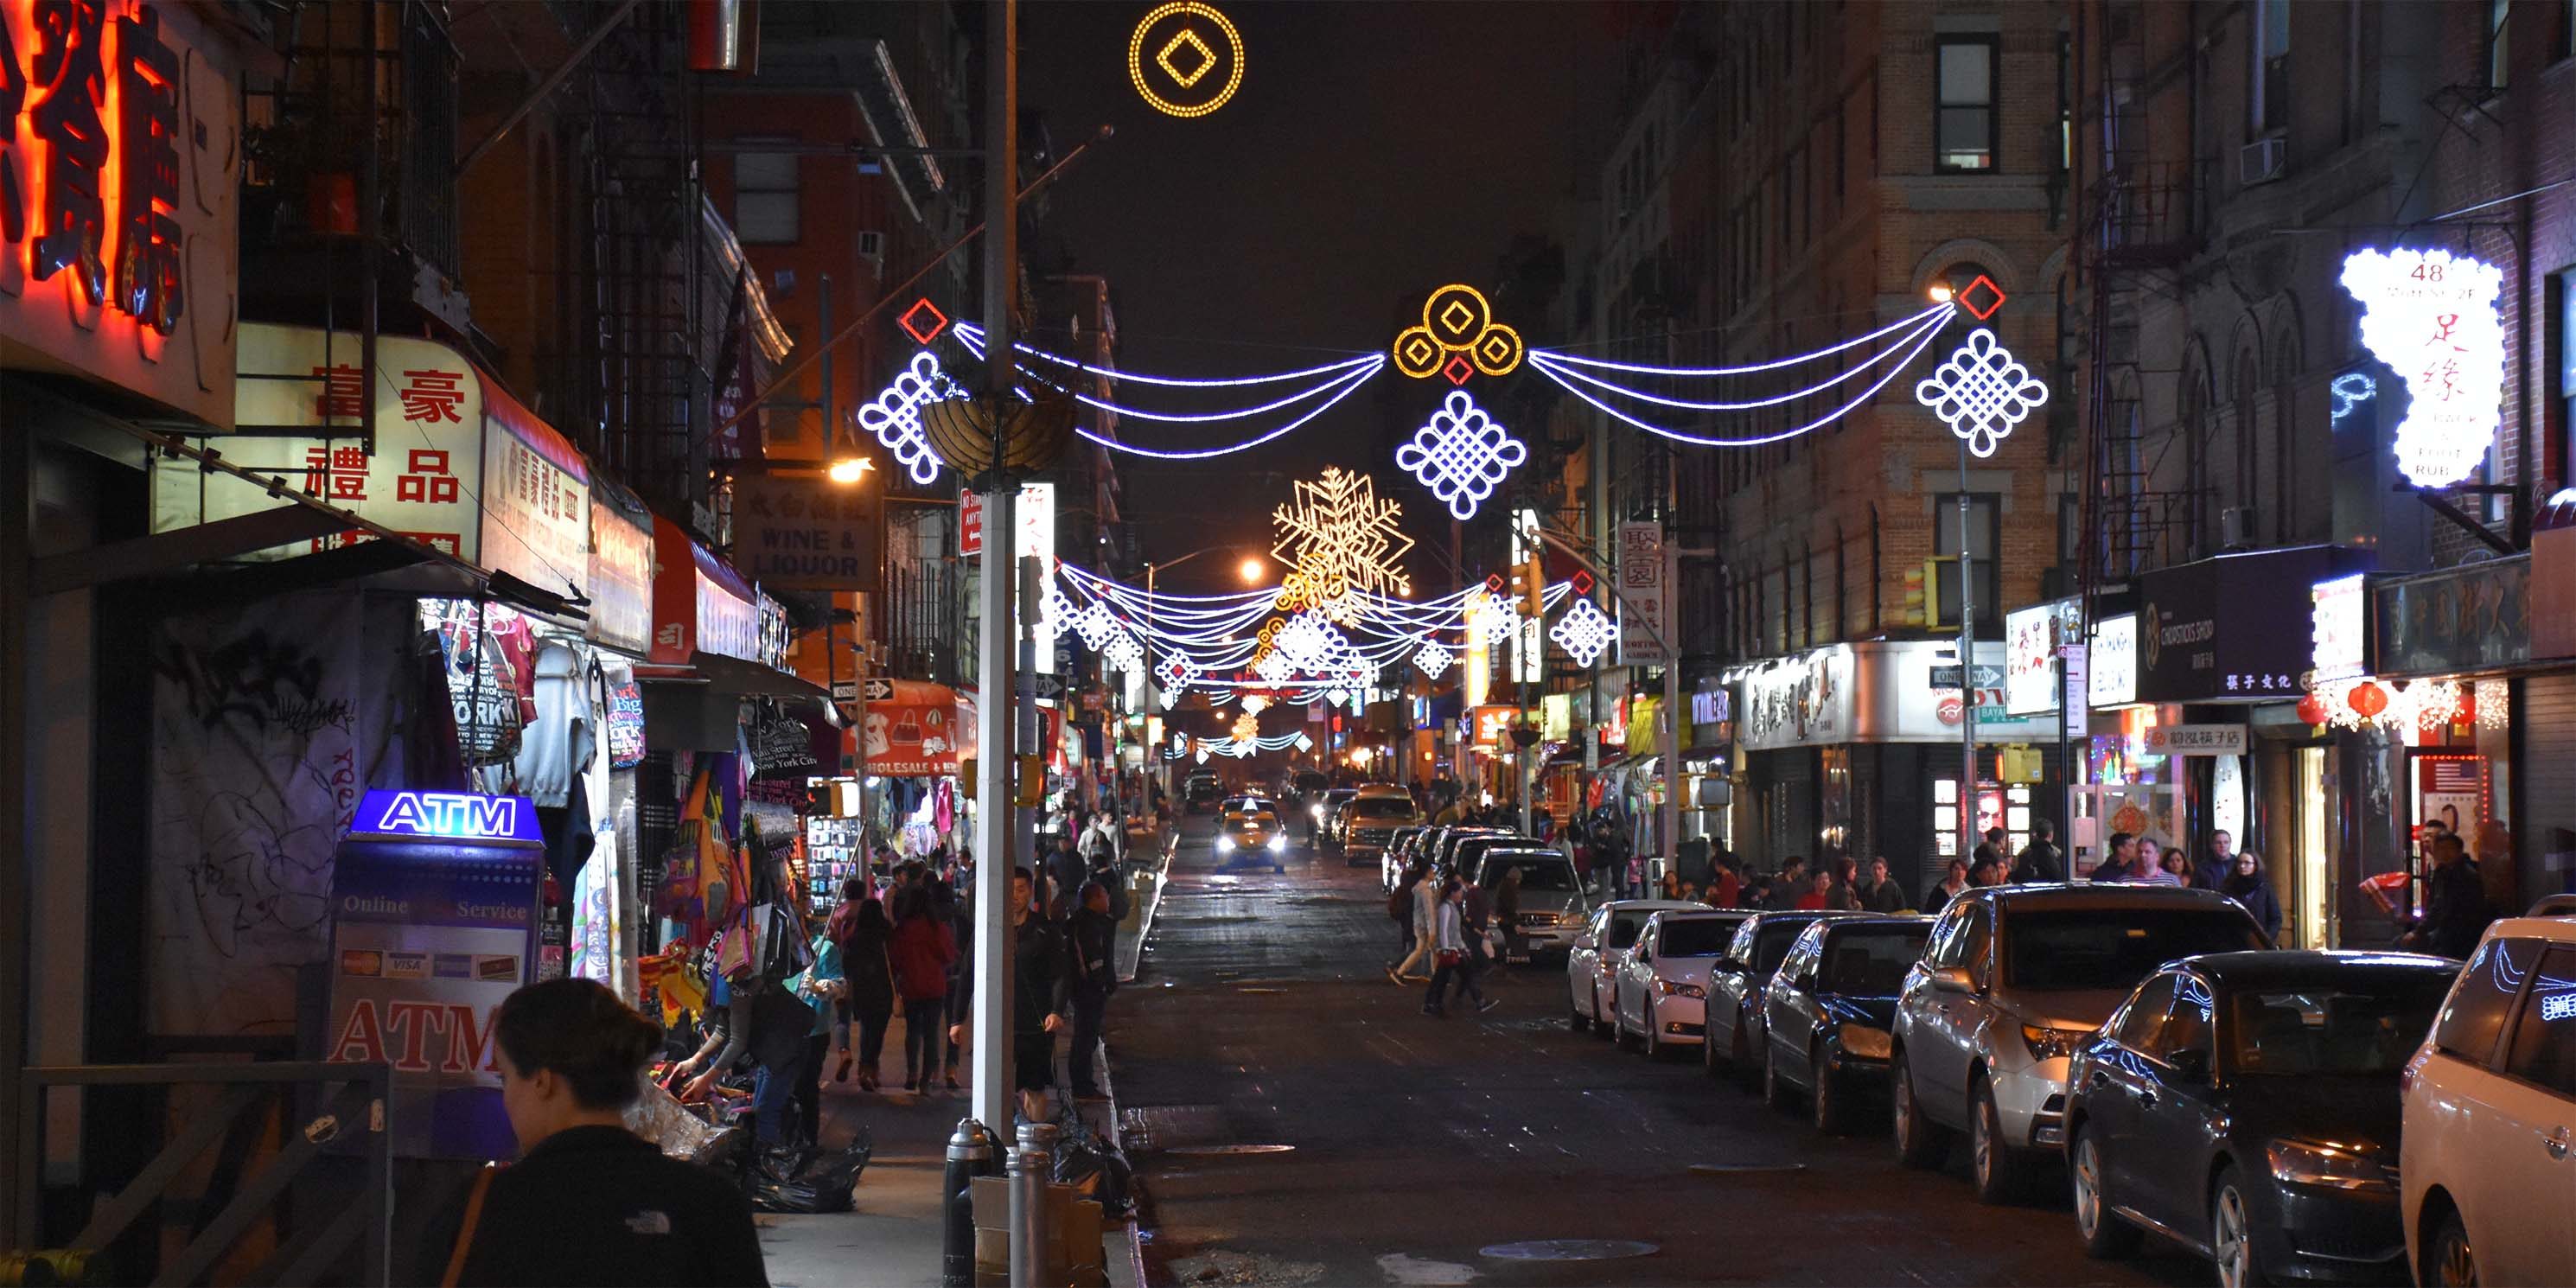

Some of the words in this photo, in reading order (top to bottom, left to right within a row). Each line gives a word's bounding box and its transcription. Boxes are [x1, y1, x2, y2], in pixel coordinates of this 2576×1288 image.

[2411, 264, 2443, 282] 48
[313, 364, 464, 423] 富豪
[305, 447, 458, 503] 禮品
[761, 528, 830, 550] WINE
[841, 530, 855, 549] &
[753, 553, 858, 577] LIQUOR
[838, 687, 857, 696] ONE
[866, 685, 884, 696] WAY
[2226, 674, 2292, 690] 筷子文化
[615, 697, 643, 715] Big
[776, 758, 799, 768] York
[866, 762, 929, 774] HOLESALE
[379, 793, 516, 836] ATM
[344, 896, 408, 914] Online
[457, 902, 526, 920] Service
[392, 960, 421, 970] VISA
[328, 998, 504, 1073] ATM
